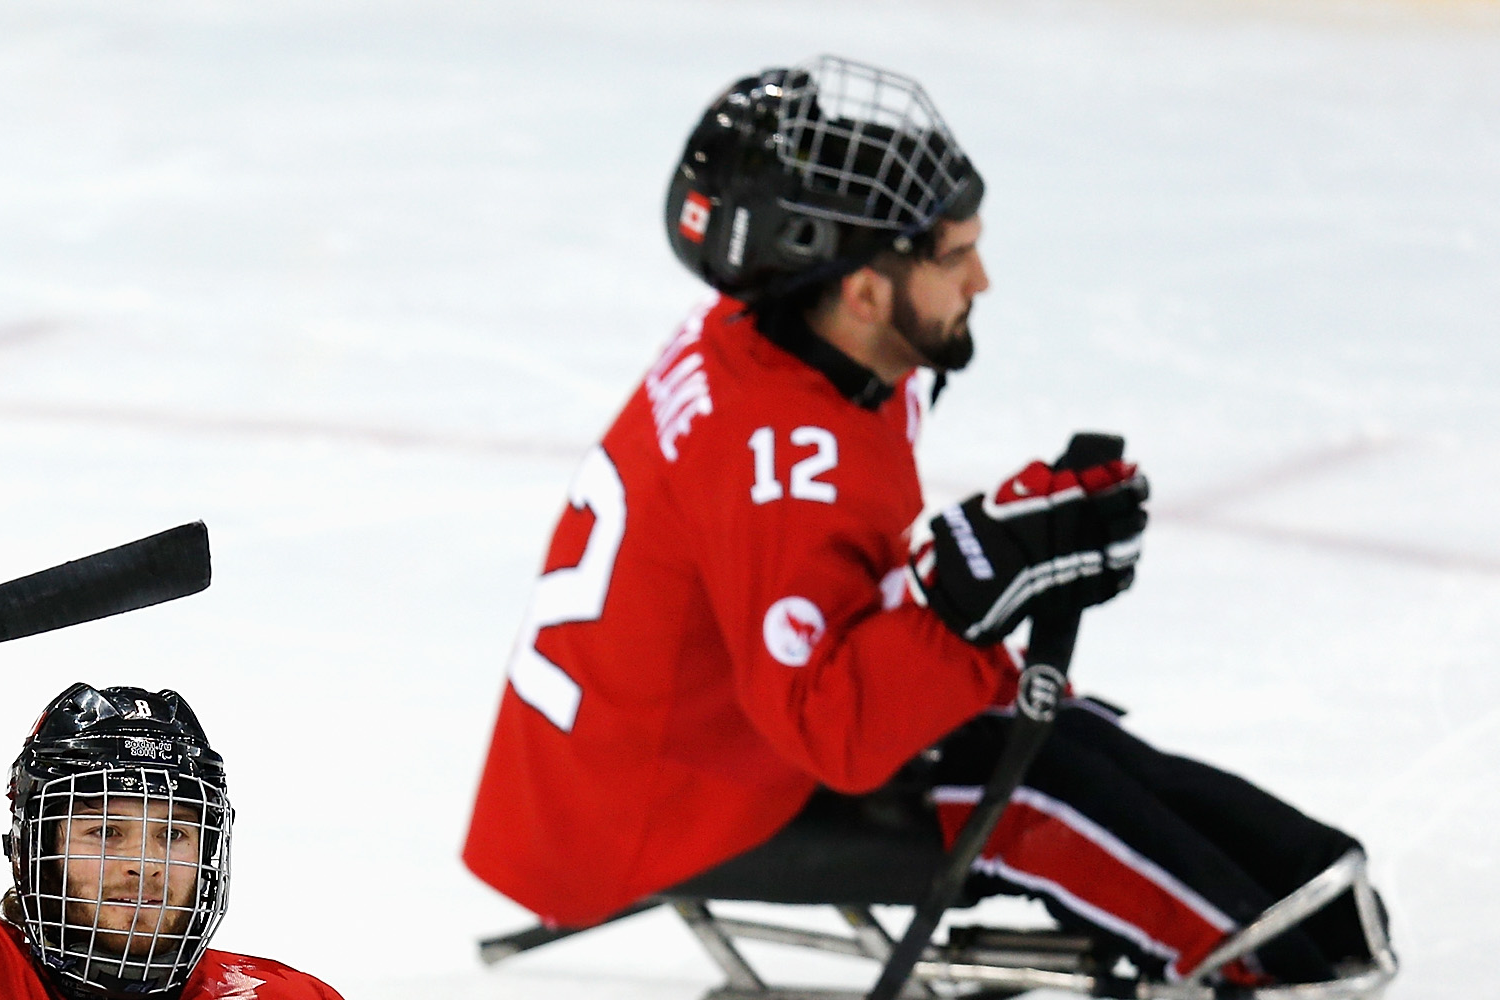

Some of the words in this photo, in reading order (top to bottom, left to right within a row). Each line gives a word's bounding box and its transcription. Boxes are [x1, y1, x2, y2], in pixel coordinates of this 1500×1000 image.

[747, 425, 839, 505] 12
[507, 443, 628, 735] 2
[134, 699, 152, 717] 8
